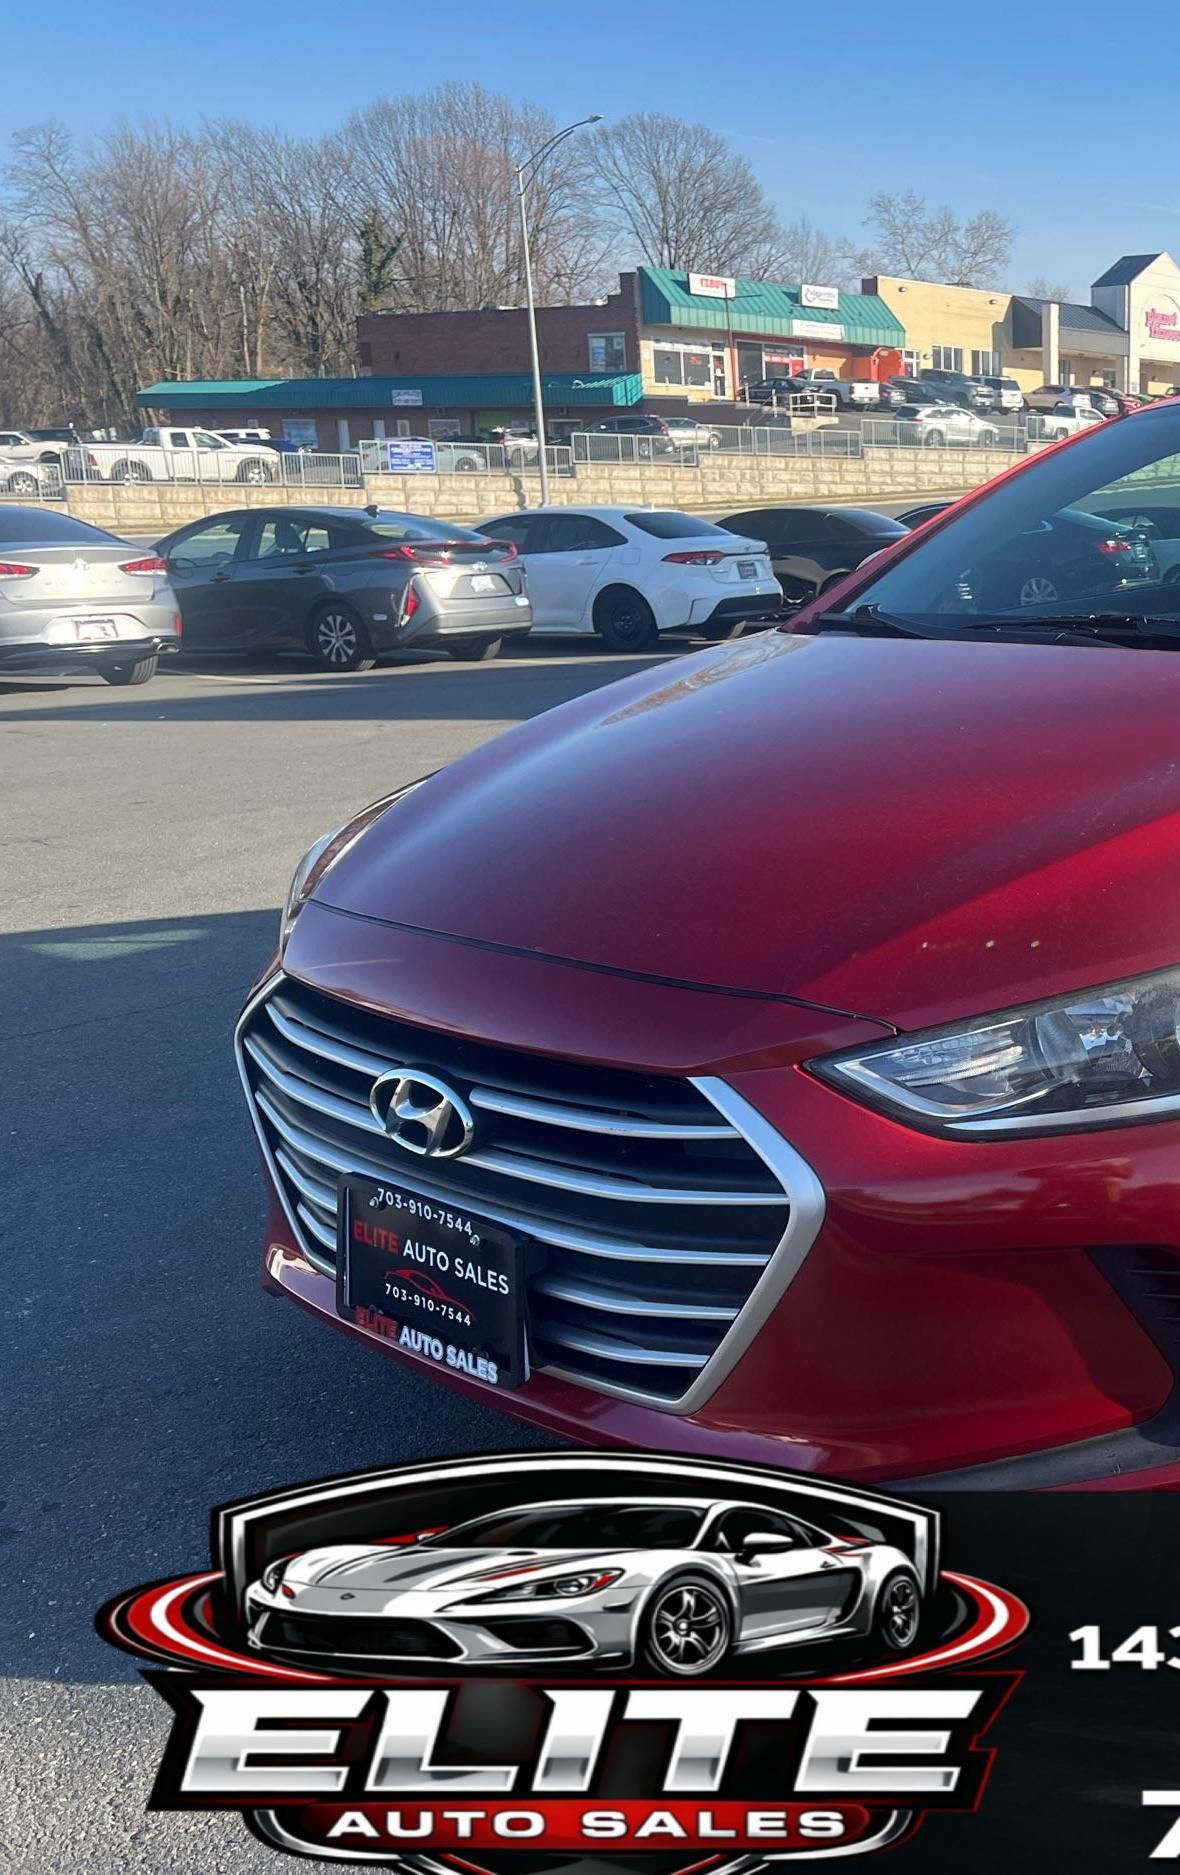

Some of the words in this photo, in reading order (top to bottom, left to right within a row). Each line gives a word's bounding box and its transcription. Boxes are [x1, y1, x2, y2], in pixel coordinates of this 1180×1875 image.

[377, 1188, 473, 1236] 703-910-7544
[353, 1218, 399, 1254] ELITE
[403, 1239, 449, 1272] AUTO
[454, 1258, 510, 1295] SALES
[385, 1283, 471, 1327] 703-910-7544
[355, 1305, 399, 1340] ELITE
[399, 1325, 444, 1361] AUTO
[446, 1344, 499, 1384] SALES
